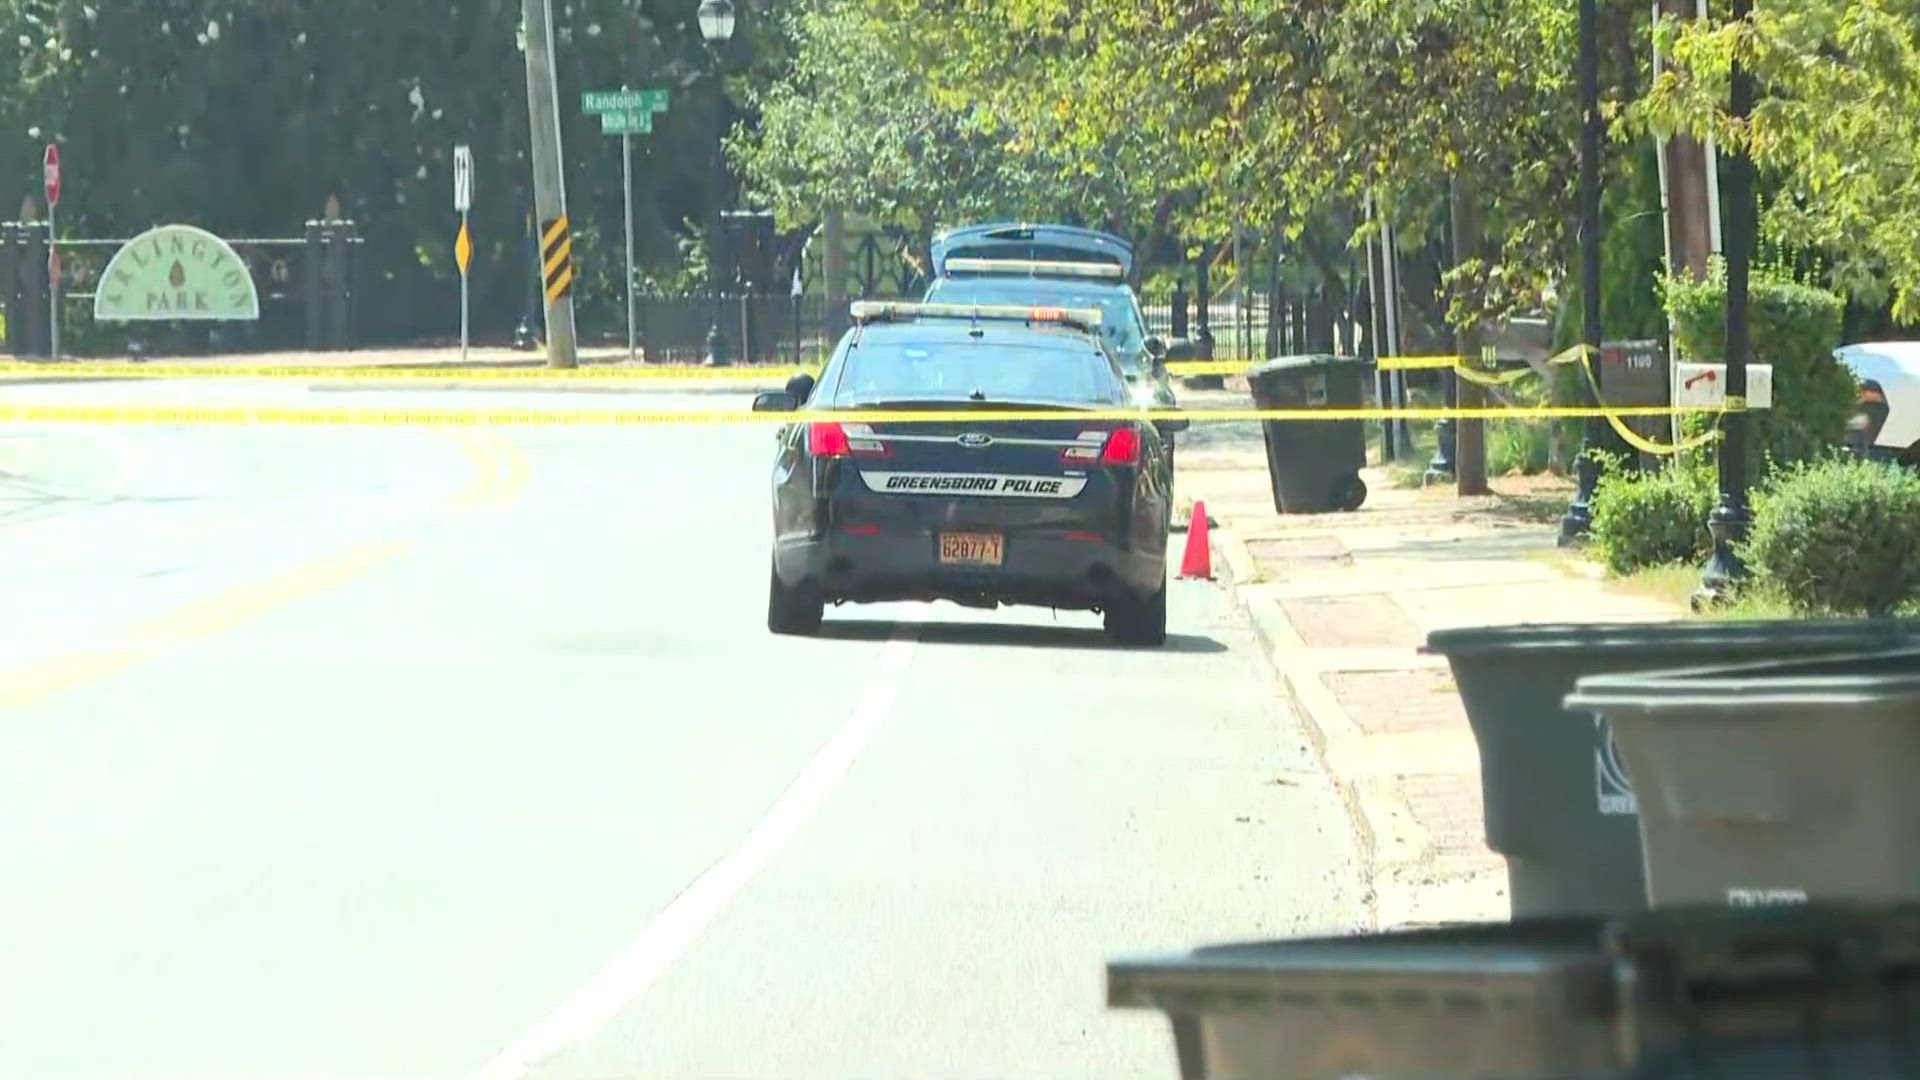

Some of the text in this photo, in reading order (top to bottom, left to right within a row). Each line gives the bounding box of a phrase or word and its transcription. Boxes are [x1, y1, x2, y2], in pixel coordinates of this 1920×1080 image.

[585, 92, 642, 110] Randolph
[106, 233, 249, 308] ARLINGTON
[146, 290, 209, 311] PARK
[886, 475, 1062, 494] GREENSBORO POLICE
